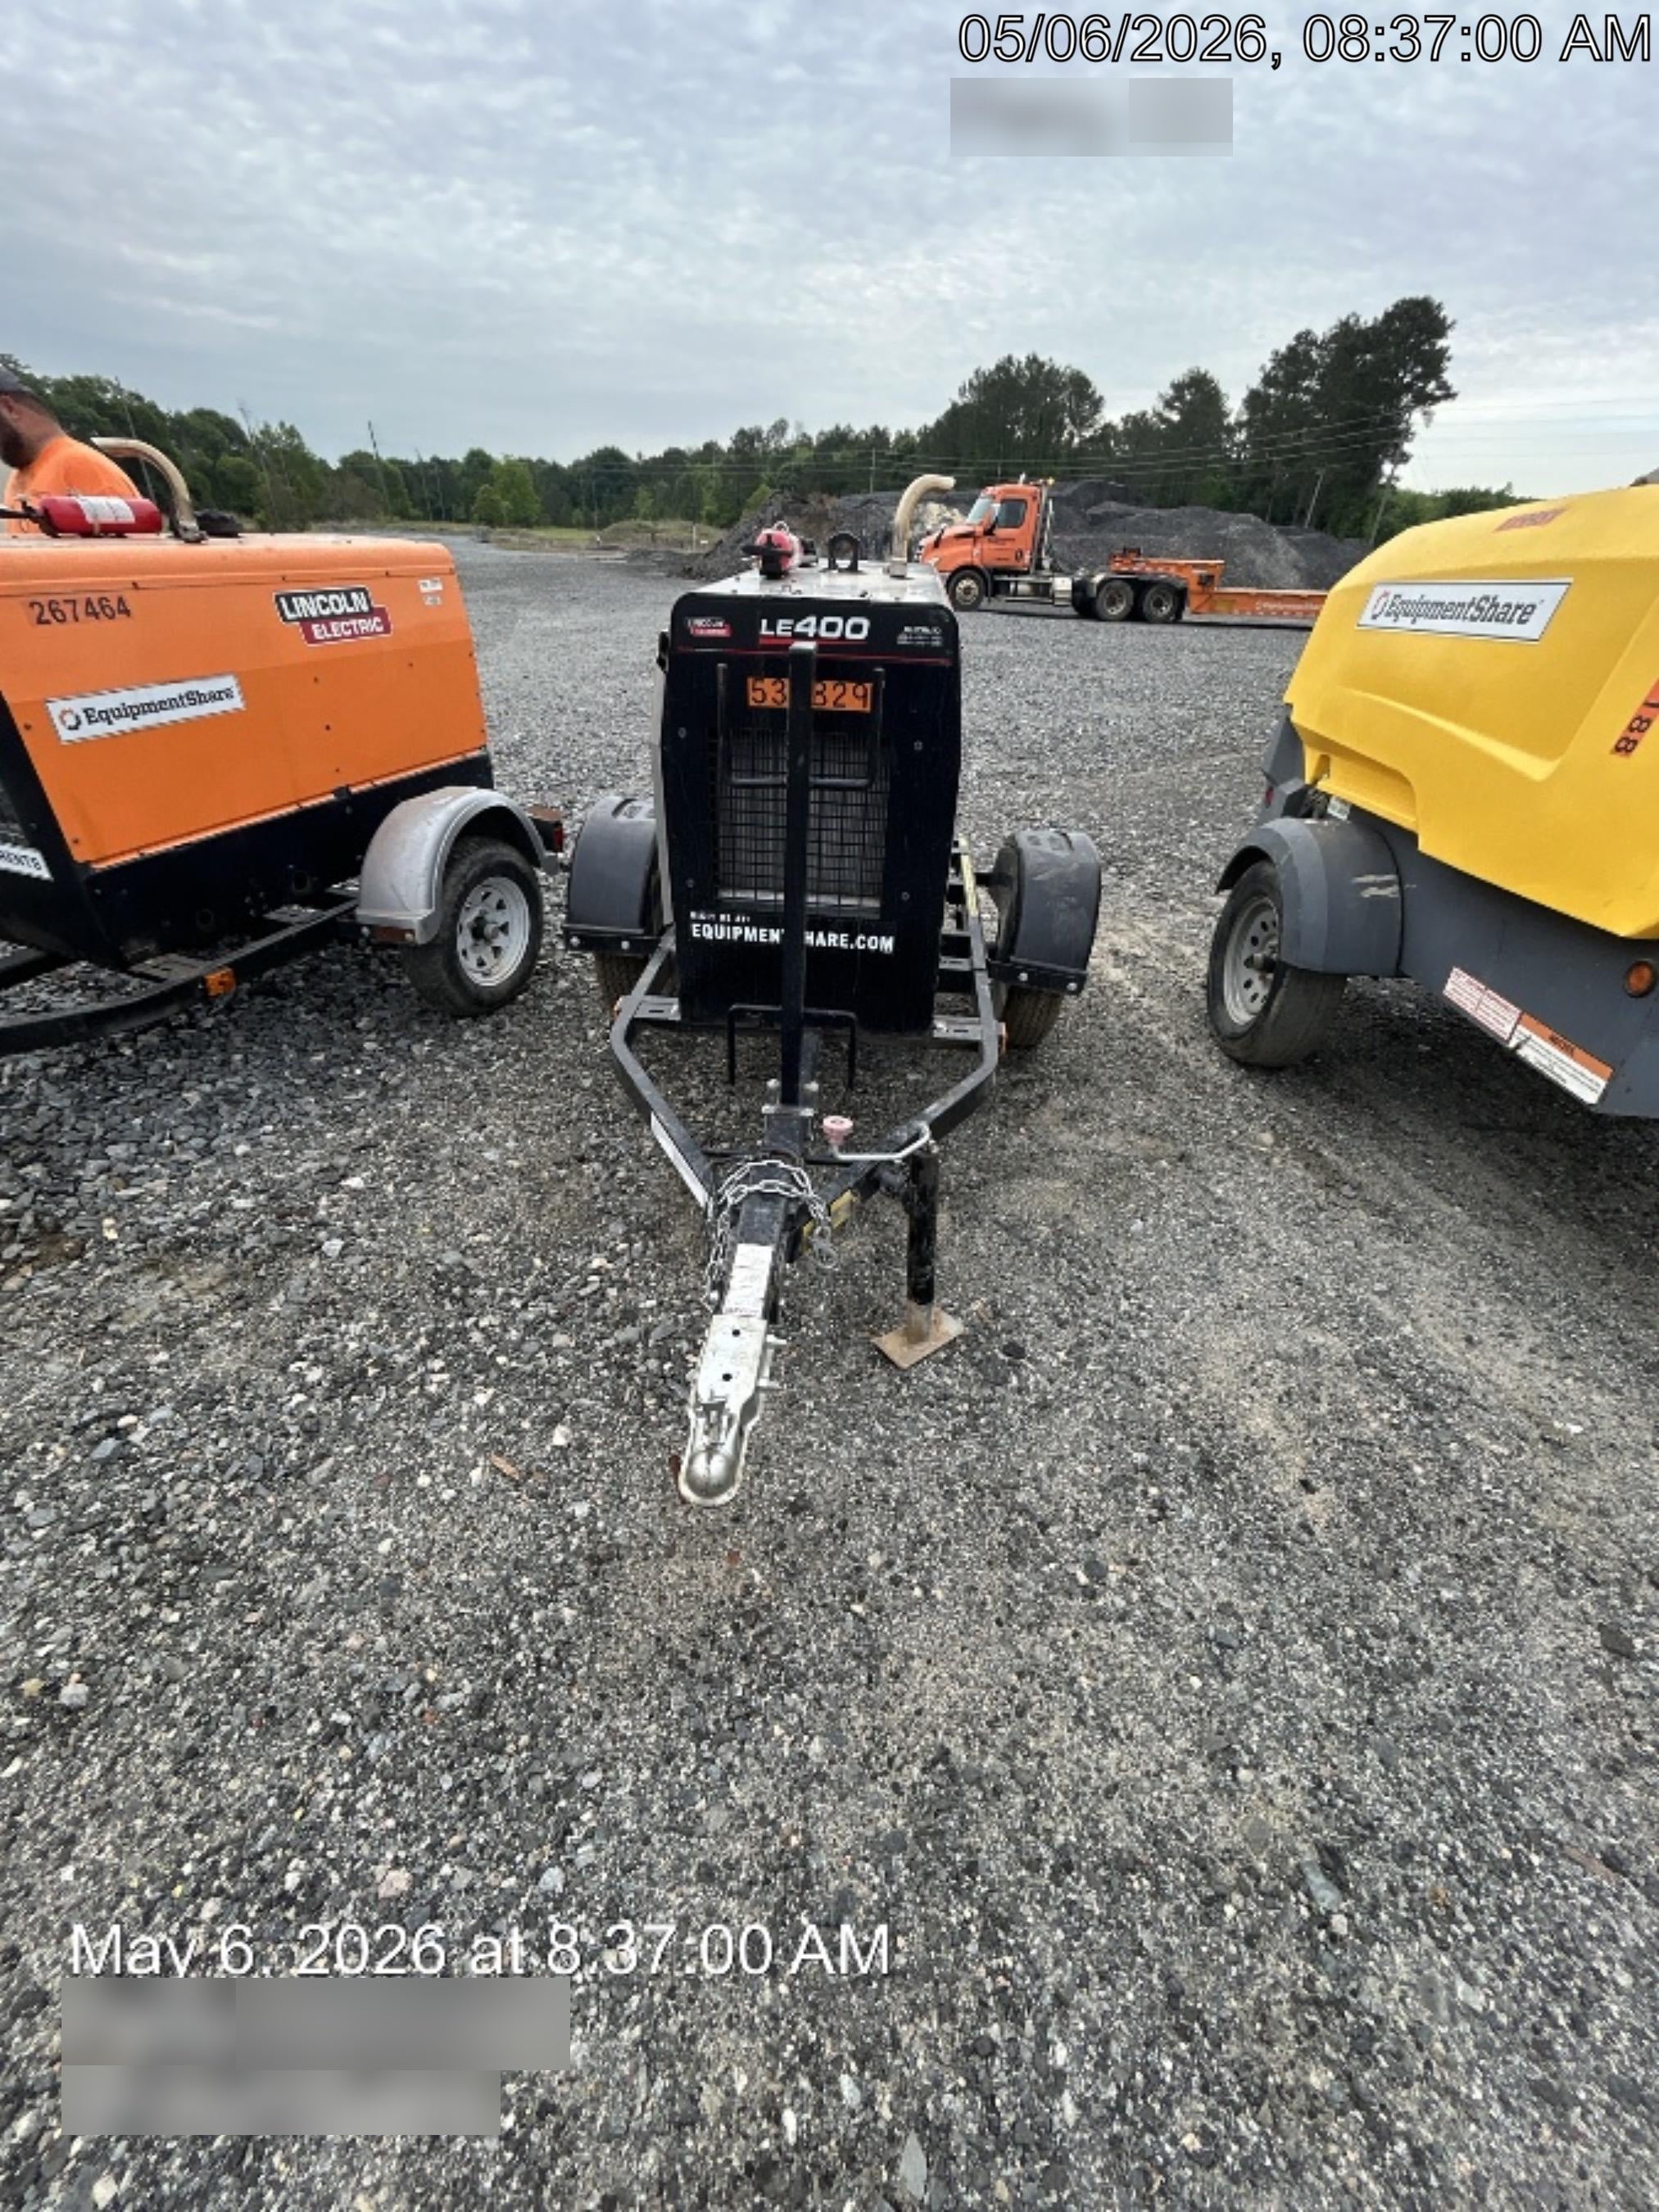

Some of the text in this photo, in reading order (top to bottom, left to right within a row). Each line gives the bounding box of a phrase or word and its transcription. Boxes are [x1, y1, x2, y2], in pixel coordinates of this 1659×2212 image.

[29, 596, 131, 625] 267464
[279, 591, 369, 620] LINCOLN
[1386, 593, 1536, 625] EquipmentShare
[311, 617, 384, 640] ELECTRIC
[760, 616, 870, 640] LE400
[83, 687, 234, 725] EquipmentShare
[750, 680, 870, 709] 53829
[691, 923, 895, 954] EQUIPMENHARE.COM
